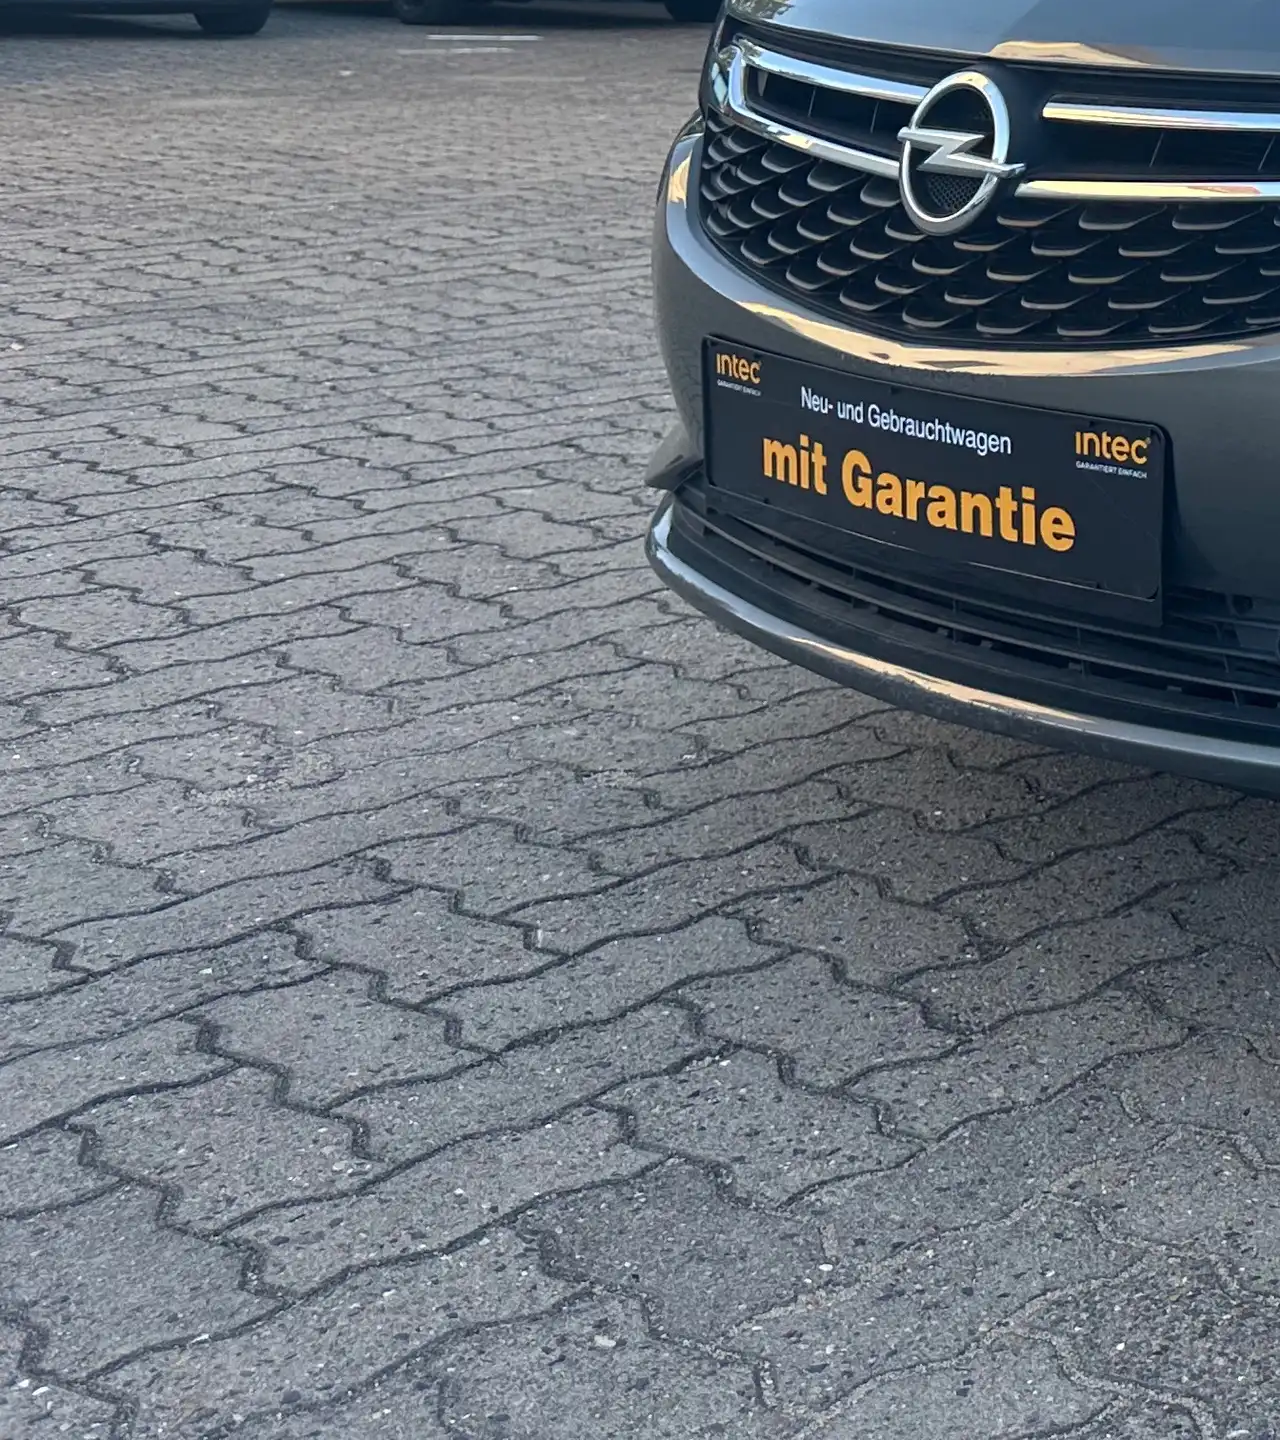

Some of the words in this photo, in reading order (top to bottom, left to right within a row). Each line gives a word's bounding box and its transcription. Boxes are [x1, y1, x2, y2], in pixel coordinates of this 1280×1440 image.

[801, 386, 834, 414] Neu-
[837, 402, 864, 424] und
[867, 404, 1012, 456] Gebrauchtwagen
[763, 433, 828, 495] mit
[841, 449, 1076, 552] Garantie
